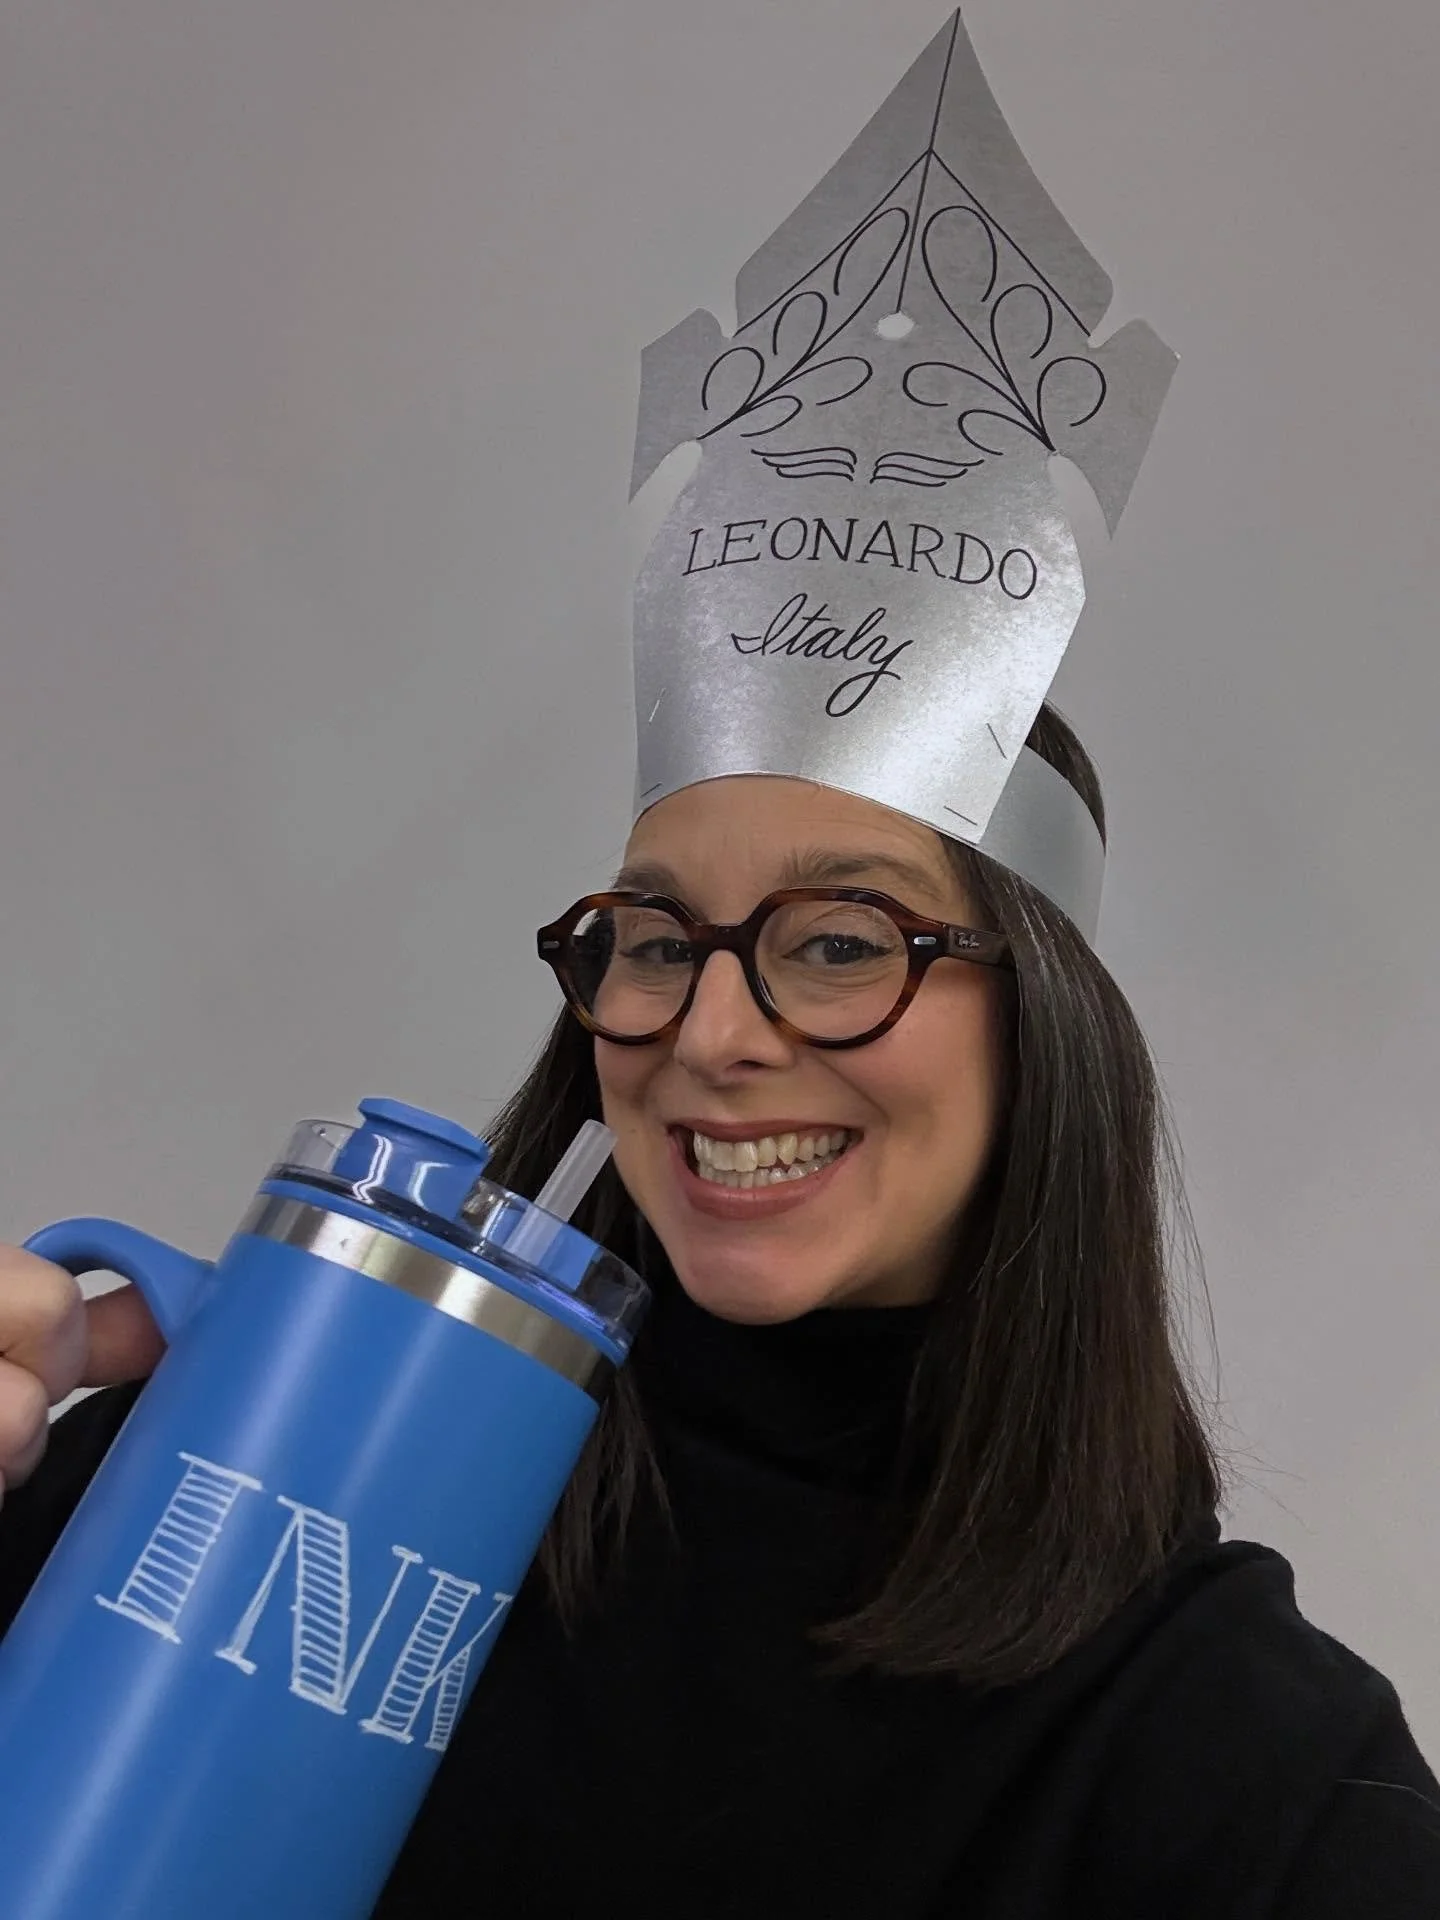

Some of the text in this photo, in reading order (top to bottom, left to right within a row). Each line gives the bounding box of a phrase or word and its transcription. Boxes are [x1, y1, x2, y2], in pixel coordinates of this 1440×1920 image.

[682, 517, 1037, 600] LEONARDO
[731, 593, 913, 717] Italy
[95, 1452, 513, 1751] INK
